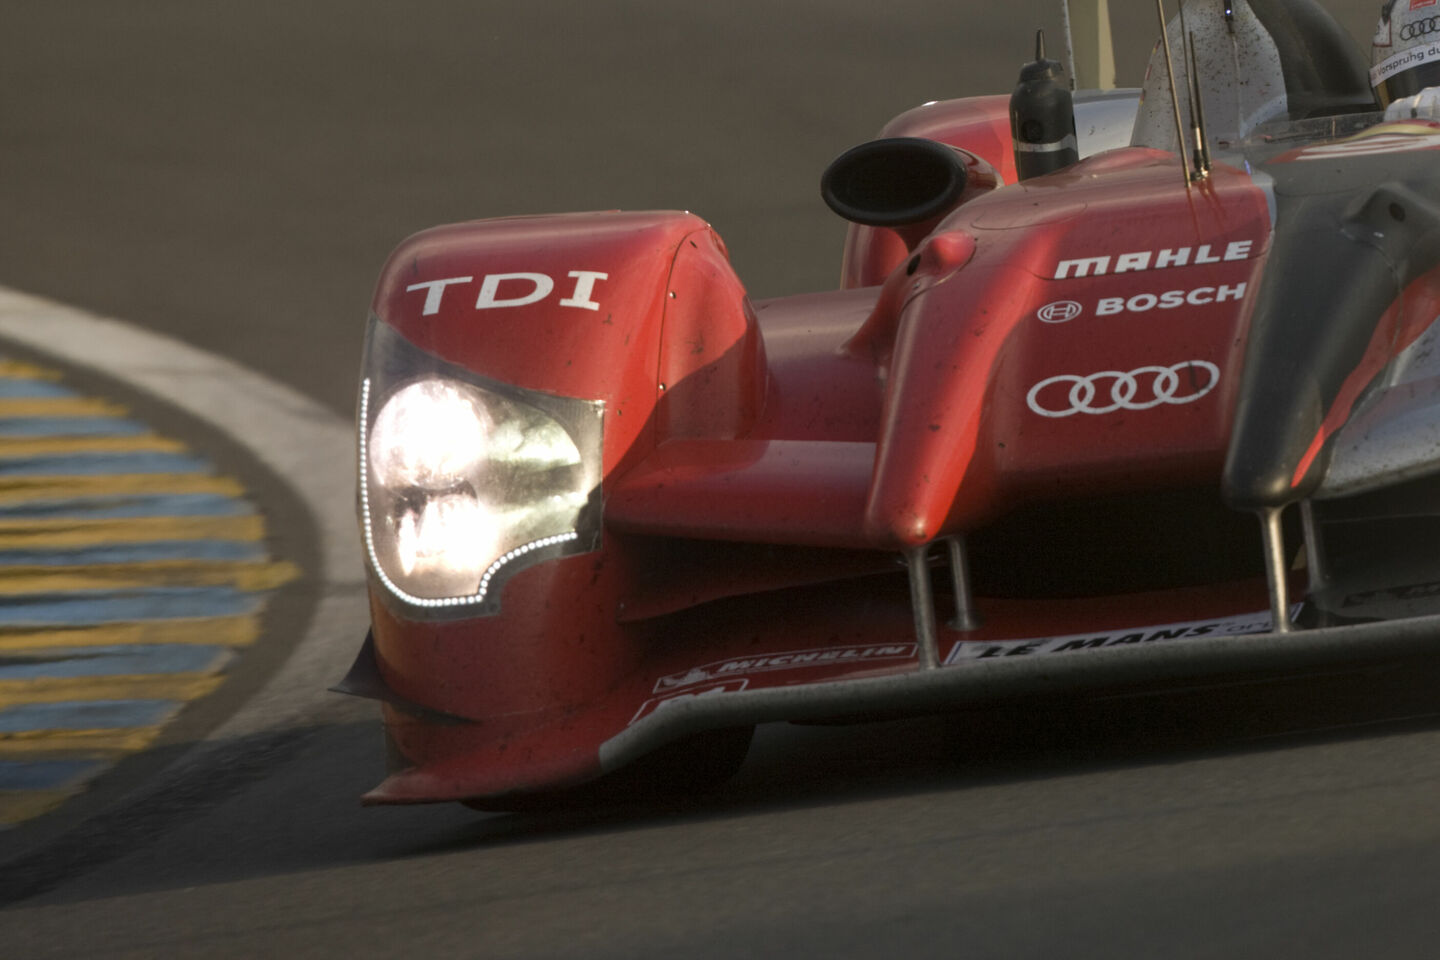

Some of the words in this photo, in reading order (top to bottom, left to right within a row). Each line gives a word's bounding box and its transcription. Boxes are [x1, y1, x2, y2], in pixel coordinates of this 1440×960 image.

[1377, 50, 1425, 76] Vorsprung
[405, 270, 608, 316] TDI
[1095, 282, 1247, 317] BOSCH
[717, 645, 909, 674] MICHELIN
